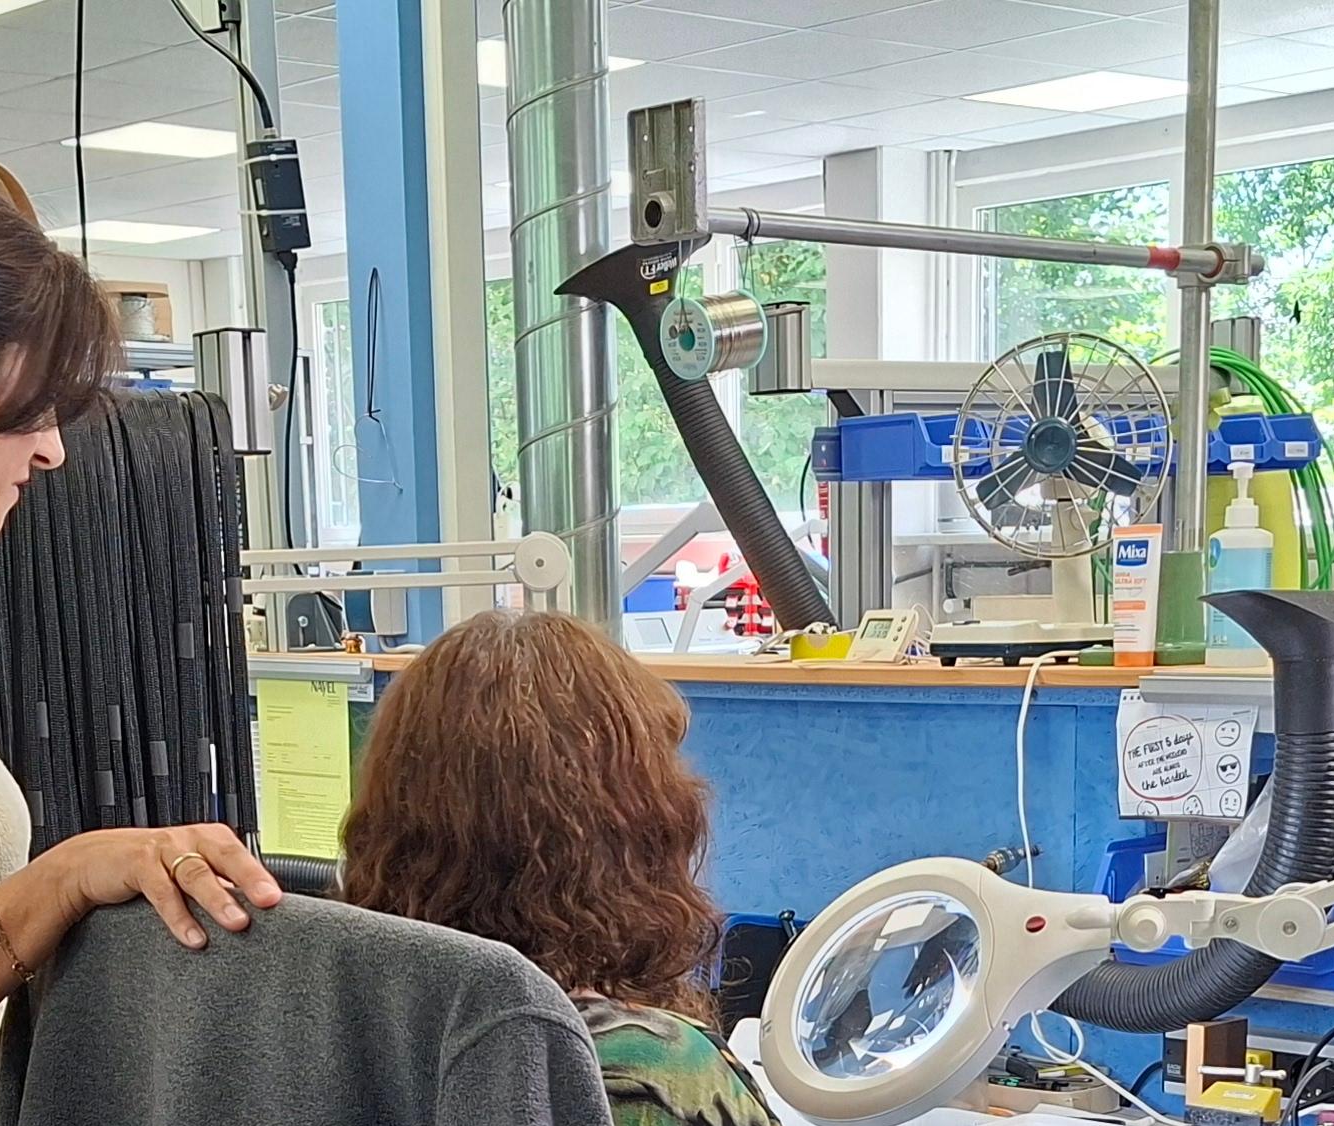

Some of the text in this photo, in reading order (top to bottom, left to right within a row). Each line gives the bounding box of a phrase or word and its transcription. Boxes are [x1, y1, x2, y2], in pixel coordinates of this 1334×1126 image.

[1118, 544, 1146, 559] Mixa
[1127, 732, 1194, 760] THE FIRST 5 days
[1138, 759, 1155, 768] AFTER
[1141, 778, 1157, 790] the
